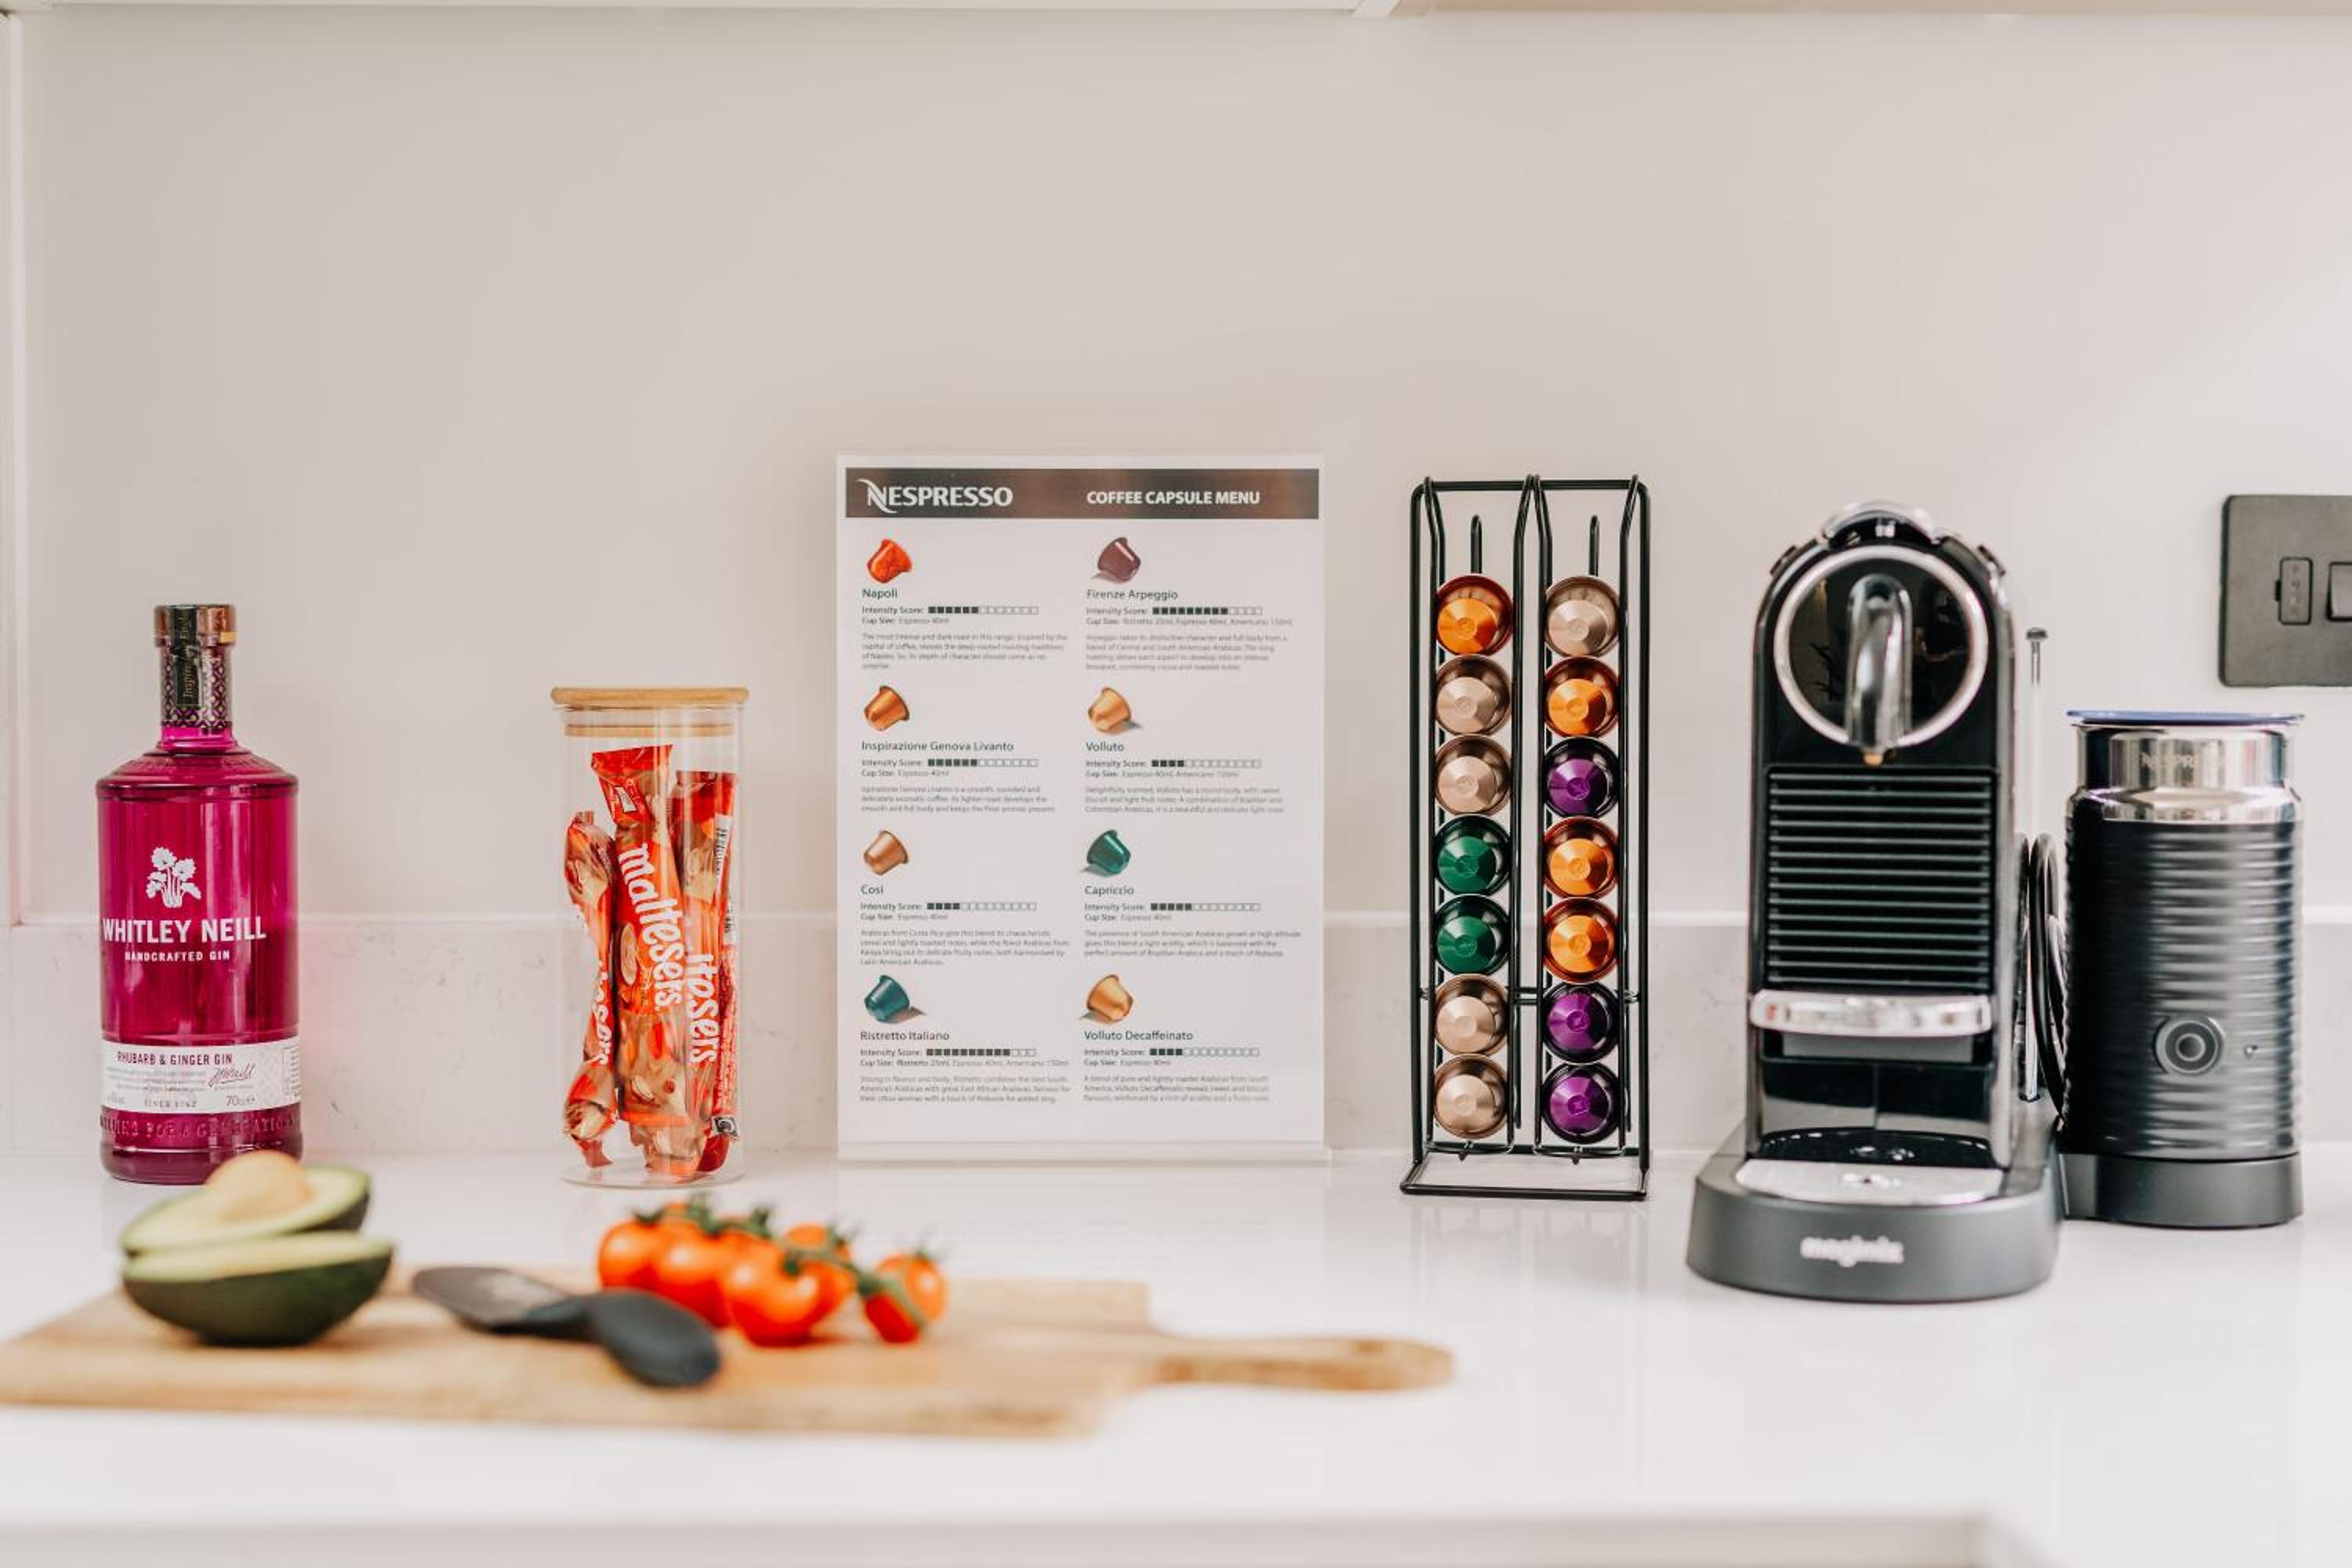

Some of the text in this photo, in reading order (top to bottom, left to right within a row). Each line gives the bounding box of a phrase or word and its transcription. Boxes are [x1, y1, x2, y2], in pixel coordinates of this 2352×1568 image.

[855, 478, 1014, 514] NESPRESSO
[1086, 491, 1261, 505] COFFEE CAPSULE MENU
[862, 589, 898, 598] Napoli
[1086, 590, 1178, 601] Firenze Arpeggio
[929, 742, 971, 751] Genova
[973, 742, 1014, 751] Livanto
[1086, 742, 1125, 752] Volluto
[860, 884, 884, 895] Cosi
[1084, 886, 1134, 895] Capriccio
[103, 916, 267, 944] WHITLEY NEILL
[618, 842, 684, 1007] maltesers
[125, 950, 230, 963] HANDCRAFTED GIN
[687, 953, 719, 1063] ltesers
[860, 1032, 949, 1040] Ristretto Italiano
[1084, 1031, 1194, 1040] Volluto Decaffeinato
[118, 1051, 233, 1065] RHUBARB & GINGER GIN
